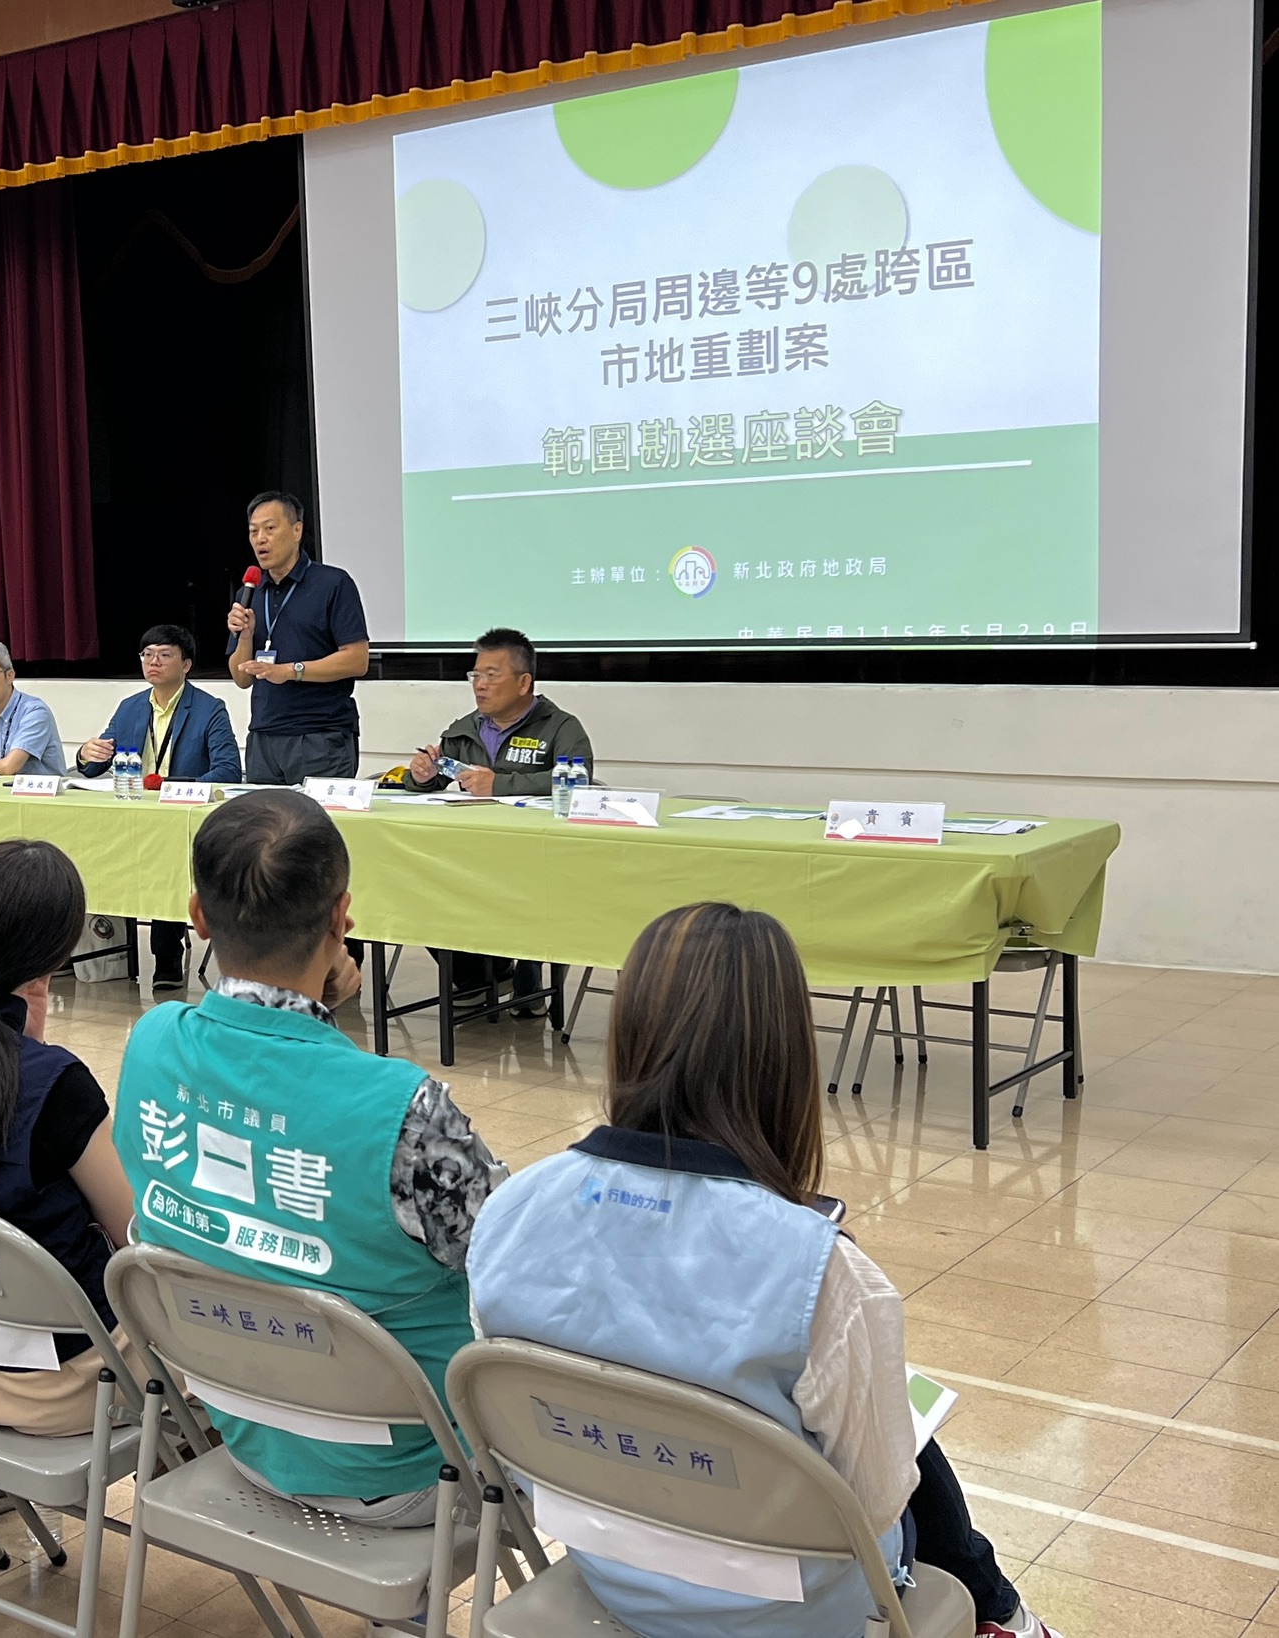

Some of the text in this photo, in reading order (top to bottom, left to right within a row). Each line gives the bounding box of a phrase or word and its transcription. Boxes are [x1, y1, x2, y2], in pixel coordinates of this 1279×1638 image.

[484, 238, 975, 343] 三峽分局周邊等9處跨區
[601, 322, 830, 389] 市地重劃案
[541, 400, 904, 477] 範圍勘選座談會
[733, 556, 888, 580] 新北政府地政局
[505, 746, 546, 765] 林銘仁
[27, 780, 53, 790] 地政局
[175, 788, 205, 797] 主持人
[865, 808, 915, 827] 貴賓
[175, 1083, 287, 1136] 新北市議員
[607, 1187, 672, 1214] 行動的力量
[235, 1225, 322, 1265] 服務團隊
[188, 1299, 315, 1344] 三峽區公所
[551, 1416, 715, 1477] 三峽區公所
